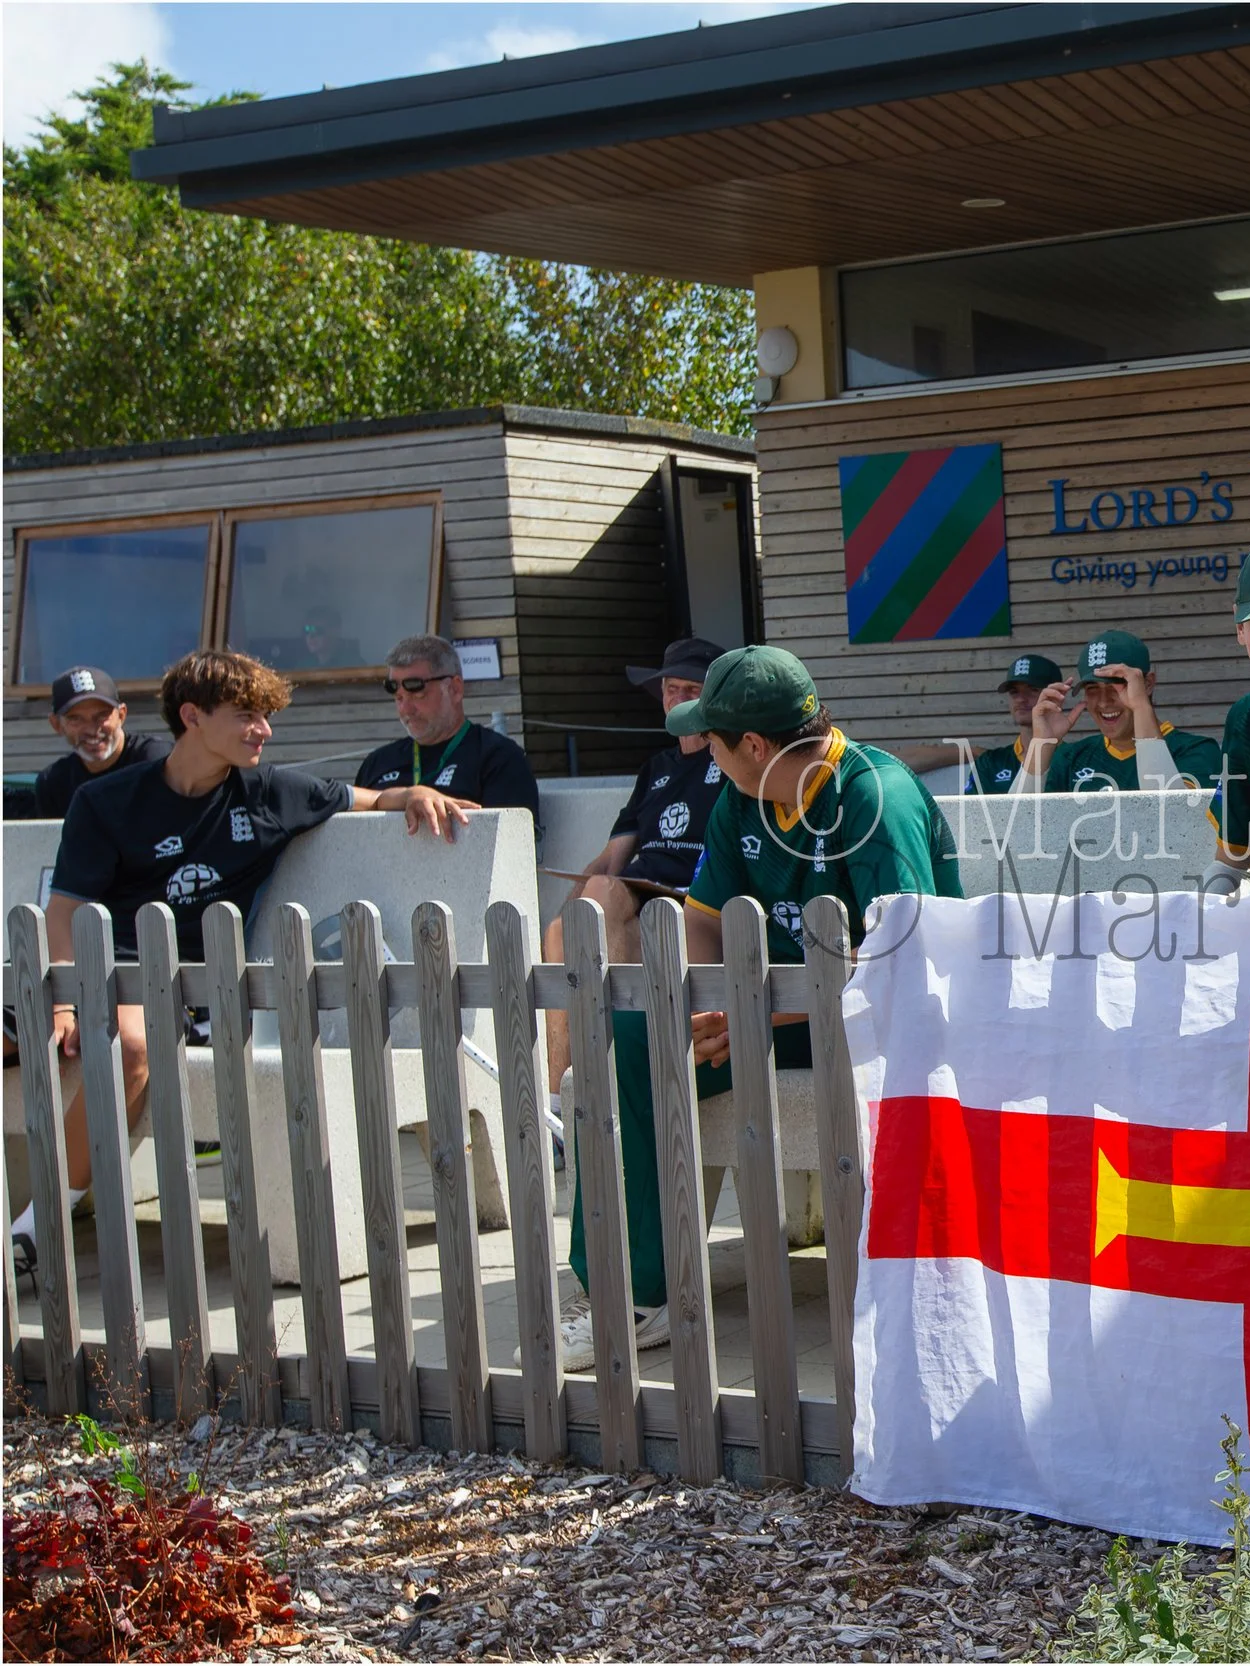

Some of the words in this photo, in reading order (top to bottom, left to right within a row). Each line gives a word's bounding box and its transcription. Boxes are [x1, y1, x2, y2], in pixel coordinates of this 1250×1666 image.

[1048, 470, 1234, 535] LORD'S
[1051, 556, 1137, 589] Giving
[1147, 552, 1229, 587] young
